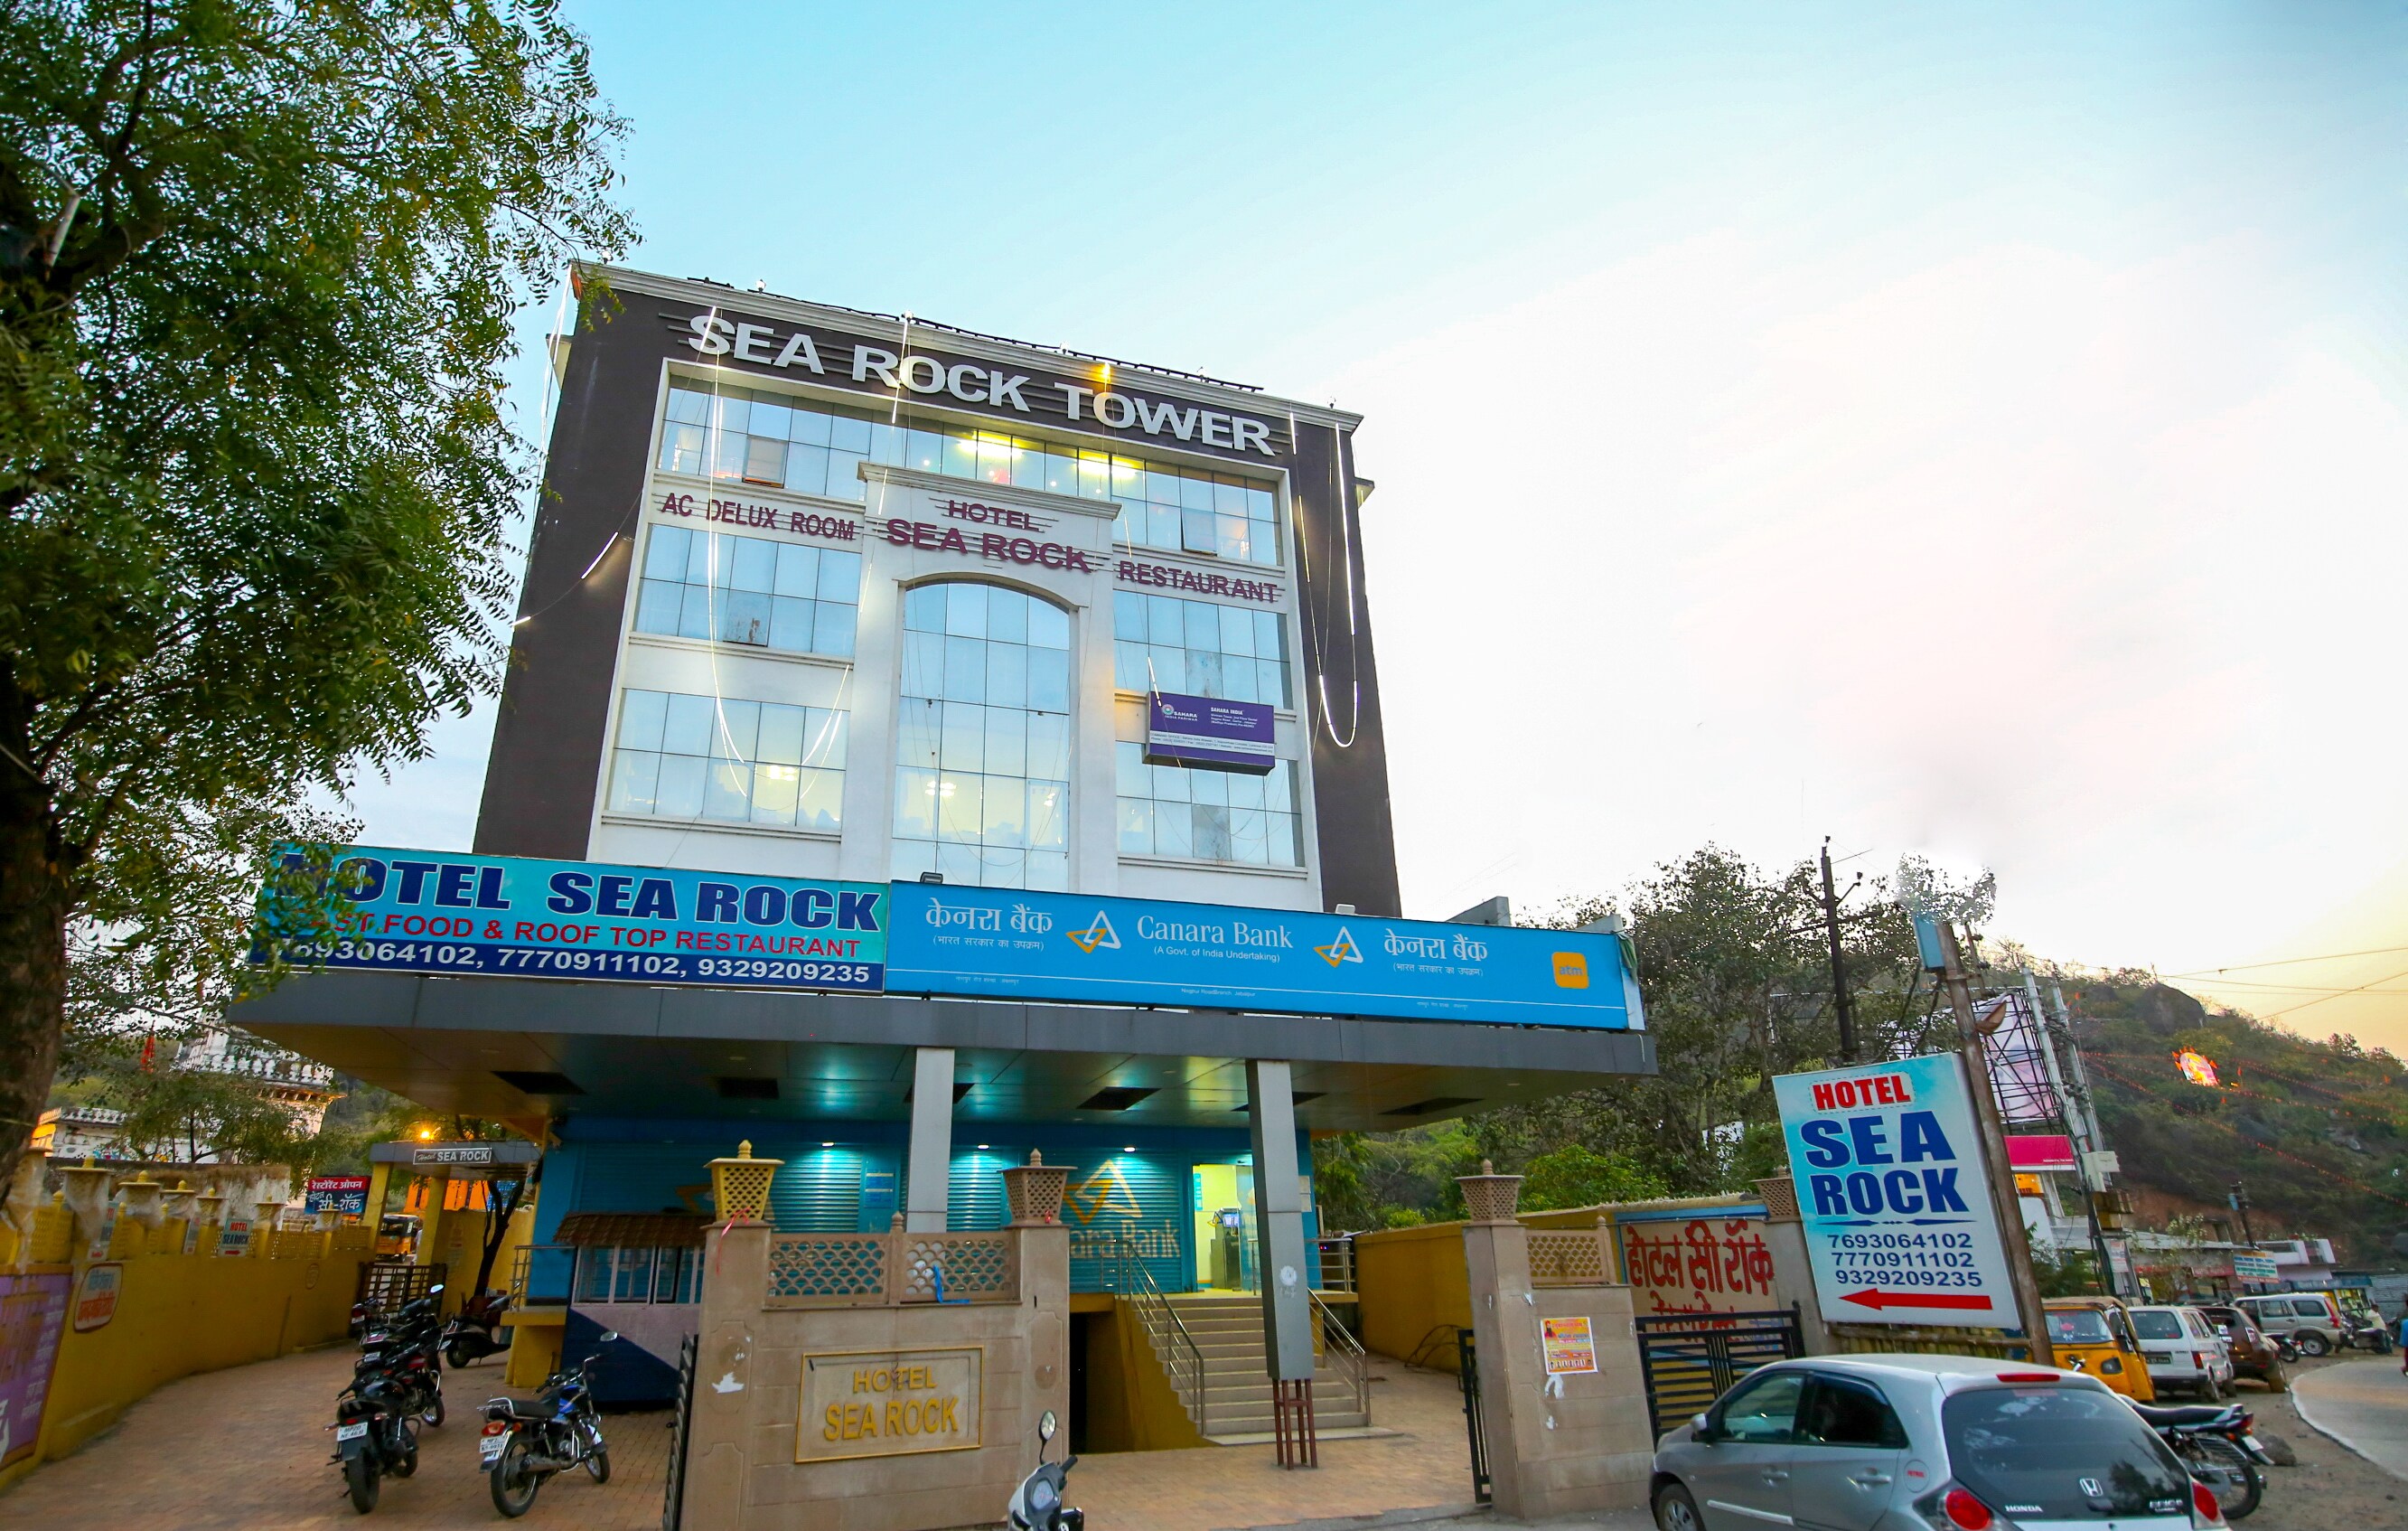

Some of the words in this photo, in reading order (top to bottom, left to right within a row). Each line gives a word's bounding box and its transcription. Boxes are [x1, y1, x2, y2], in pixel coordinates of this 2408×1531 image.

[688, 315, 824, 375] SEA
[852, 344, 1031, 412] ROCK
[1054, 382, 1276, 456] TOWER
[661, 493, 693, 516] AC
[706, 499, 778, 529] DELUX
[791, 512, 855, 540] ROOM
[949, 500, 1039, 532] HOTEL
[886, 519, 968, 554] SEA
[982, 532, 1092, 574] ROCK
[1120, 560, 1278, 603] RESTAURANT
[546, 871, 679, 921] SEA
[695, 881, 881, 932] ROCK
[925, 897, 1002, 932] केनरा
[1010, 904, 1053, 934] बैंक
[383, 914, 474, 937] FOOD
[483, 919, 503, 939] &
[514, 922, 600, 944] ROOF
[610, 926, 667, 947] TOP
[675, 931, 861, 958] RESTAURANT
[932, 935, 960, 945] (भारत
[964, 937, 995, 947] सरकार
[998, 940, 1009, 948] का
[1013, 940, 1045, 952] उपक्रम)
[1137, 915, 1224, 944] Canara
[1232, 922, 1294, 948] Bank
[1384, 928, 1447, 960] केनरा
[1453, 934, 1488, 961] बैंक
[498, 949, 688, 978] 7770911102,
[698, 958, 870, 982] 9329209235
[1154, 946, 1165, 955] (A
[1167, 946, 1189, 956] Govt.
[1203, 949, 1223, 958] India
[1226, 952, 1280, 963] Undertaking)
[1392, 963, 1415, 972] (भारत
[1418, 964, 1443, 974] सरकार
[1560, 965, 1583, 976] atm
[1812, 1075, 1911, 1110] HOTEL
[437, 1151, 457, 1161] SEA
[459, 1151, 489, 1161] ROCK
[1801, 1111, 1956, 1169] SEA
[339, 1179, 362, 1189] ओपन
[1810, 1168, 1970, 1216] ROCK
[230, 1222, 248, 1232] HOTEL
[1827, 1233, 1972, 1249] 7693064102
[1625, 1226, 1684, 1289] होटल
[1685, 1220, 1724, 1293] सी
[1722, 1219, 1775, 1296] रॉक
[1831, 1252, 1975, 1268] 7770911102
[1835, 1270, 1982, 1287] 9329209235
[853, 1366, 938, 1394] HOTEL
[823, 1402, 877, 1441] SEA
[885, 1397, 960, 1436] ROCK
[2005, 1505, 2044, 1513] HONDA
